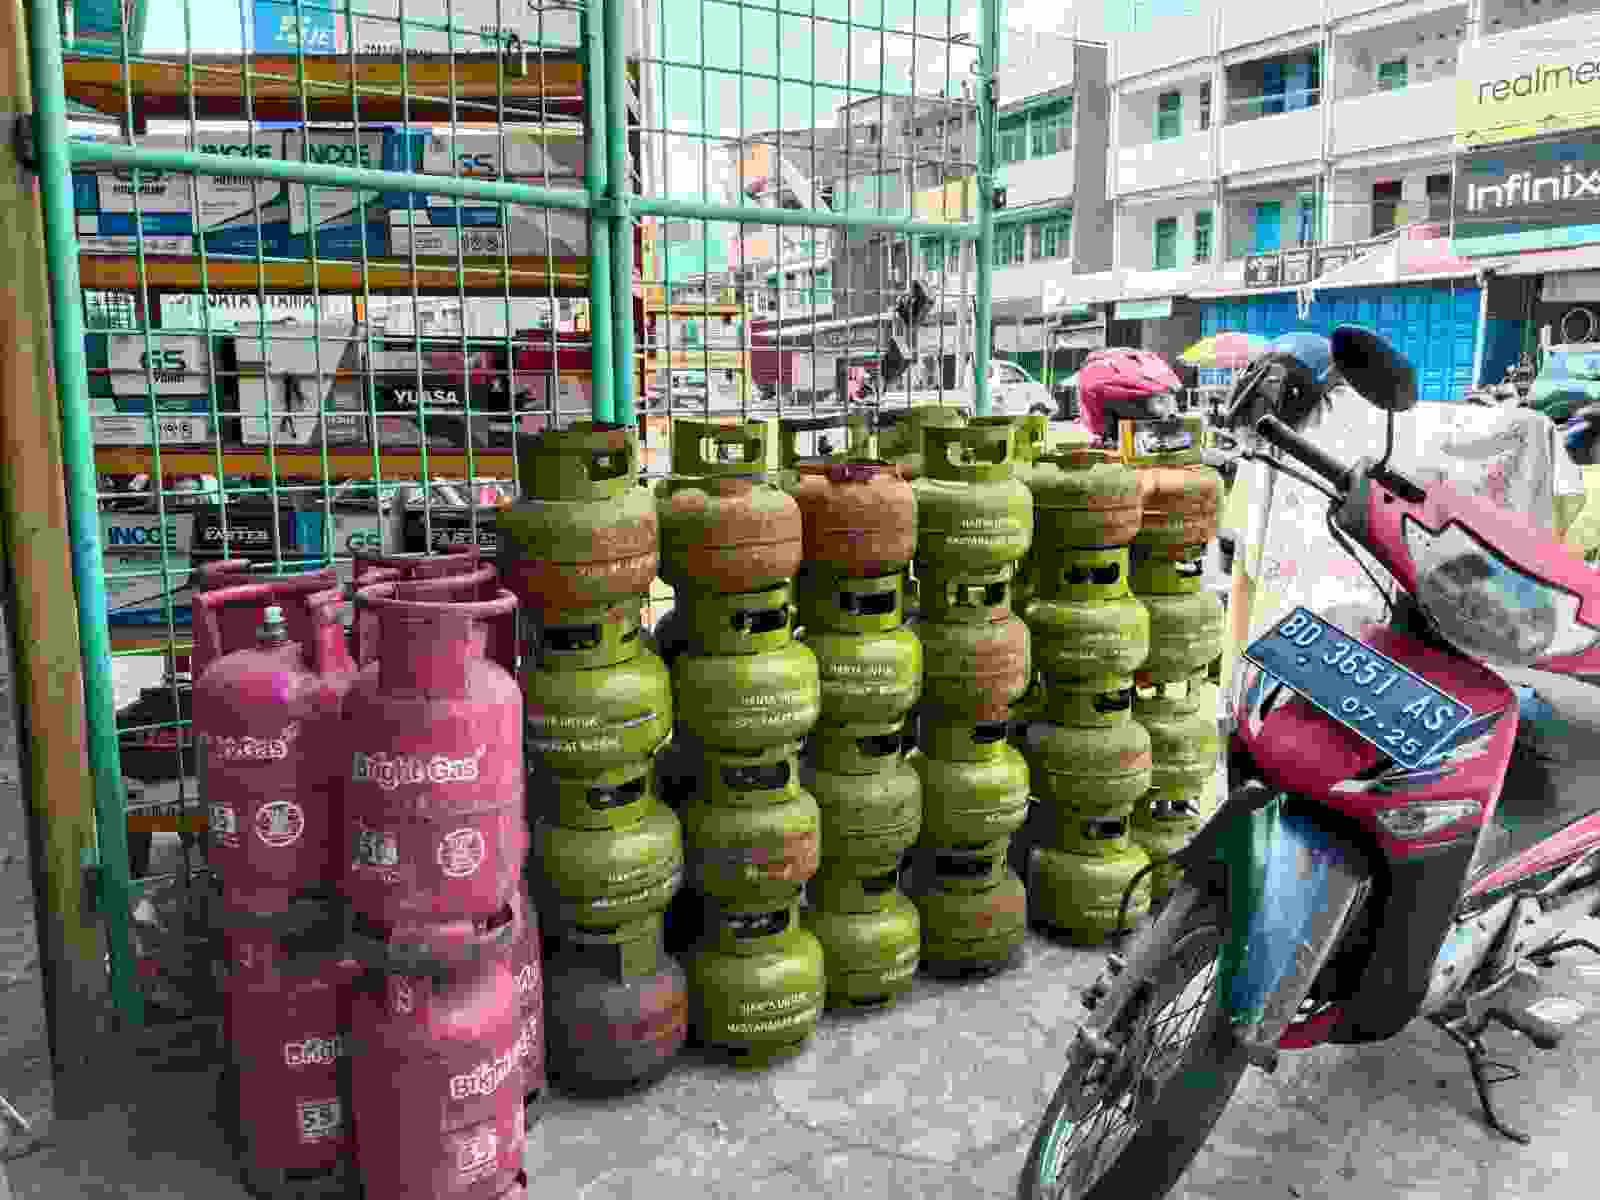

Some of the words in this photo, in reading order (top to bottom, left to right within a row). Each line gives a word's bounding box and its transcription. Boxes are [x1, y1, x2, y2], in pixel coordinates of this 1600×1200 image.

[1467, 163, 1600, 212] Infinix
[138, 350, 186, 370] GS
[393, 389, 458, 405] YUASA
[1279, 613, 1322, 646] BD
[1323, 641, 1402, 697] 3651
[1401, 695, 1456, 731] AS
